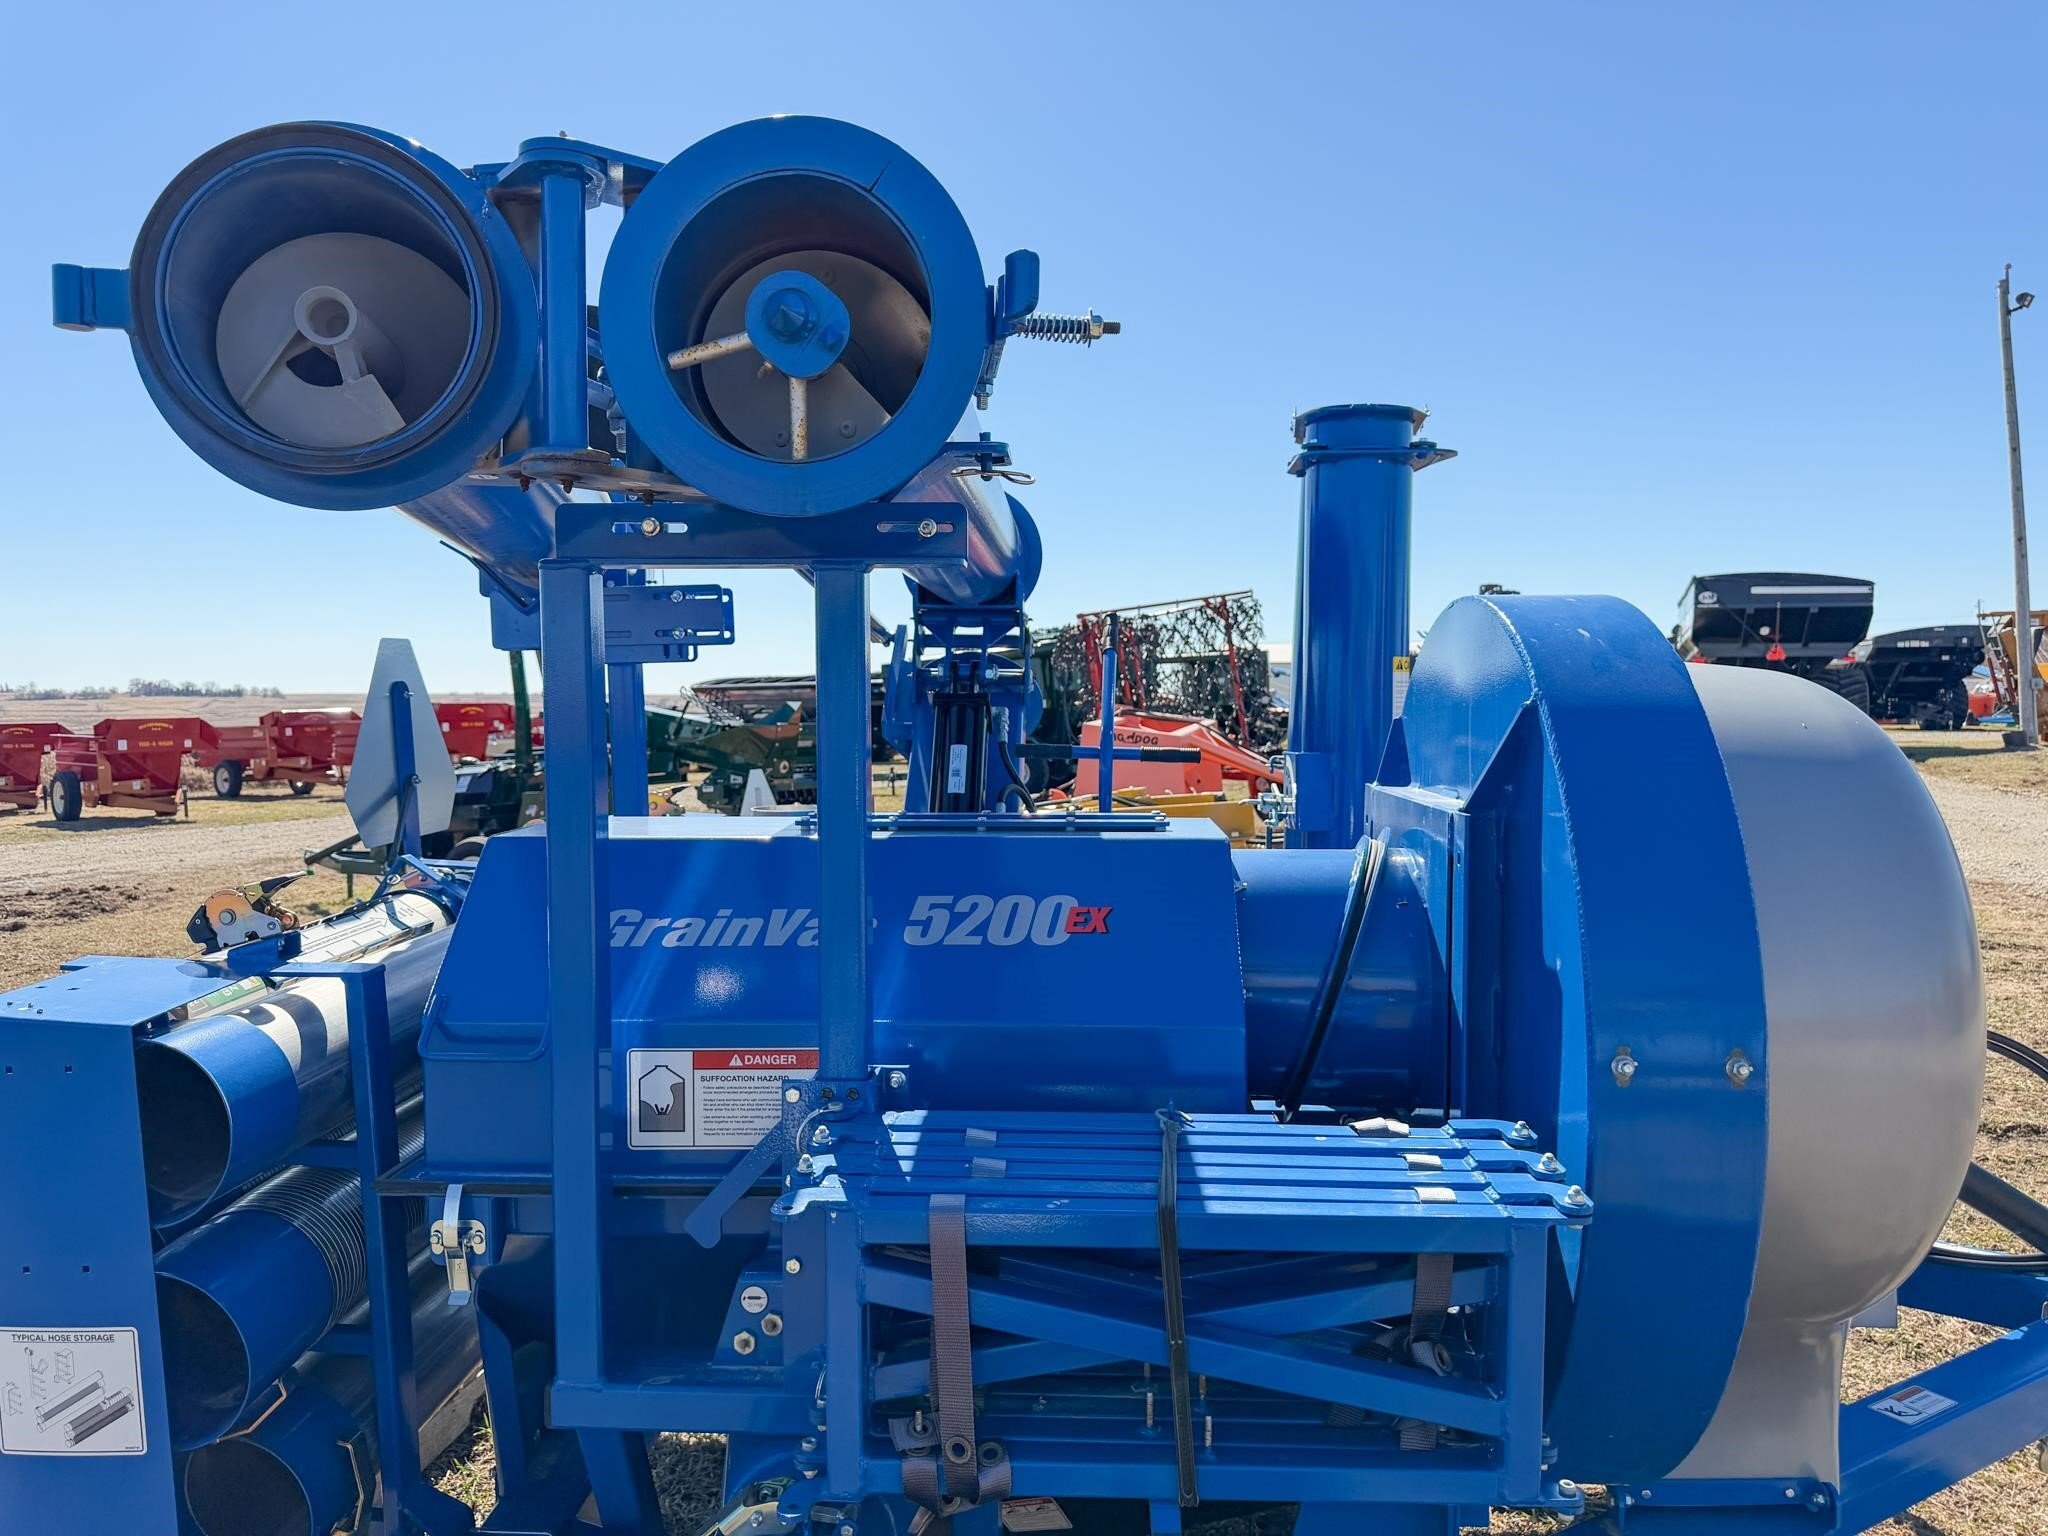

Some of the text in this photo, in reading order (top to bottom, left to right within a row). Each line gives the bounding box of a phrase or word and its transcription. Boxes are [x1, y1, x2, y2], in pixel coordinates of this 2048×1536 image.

[610, 908, 878, 947] GrainVa
[744, 1054, 797, 1065] DANGER
[73, 1334, 115, 1342] STORAGE
